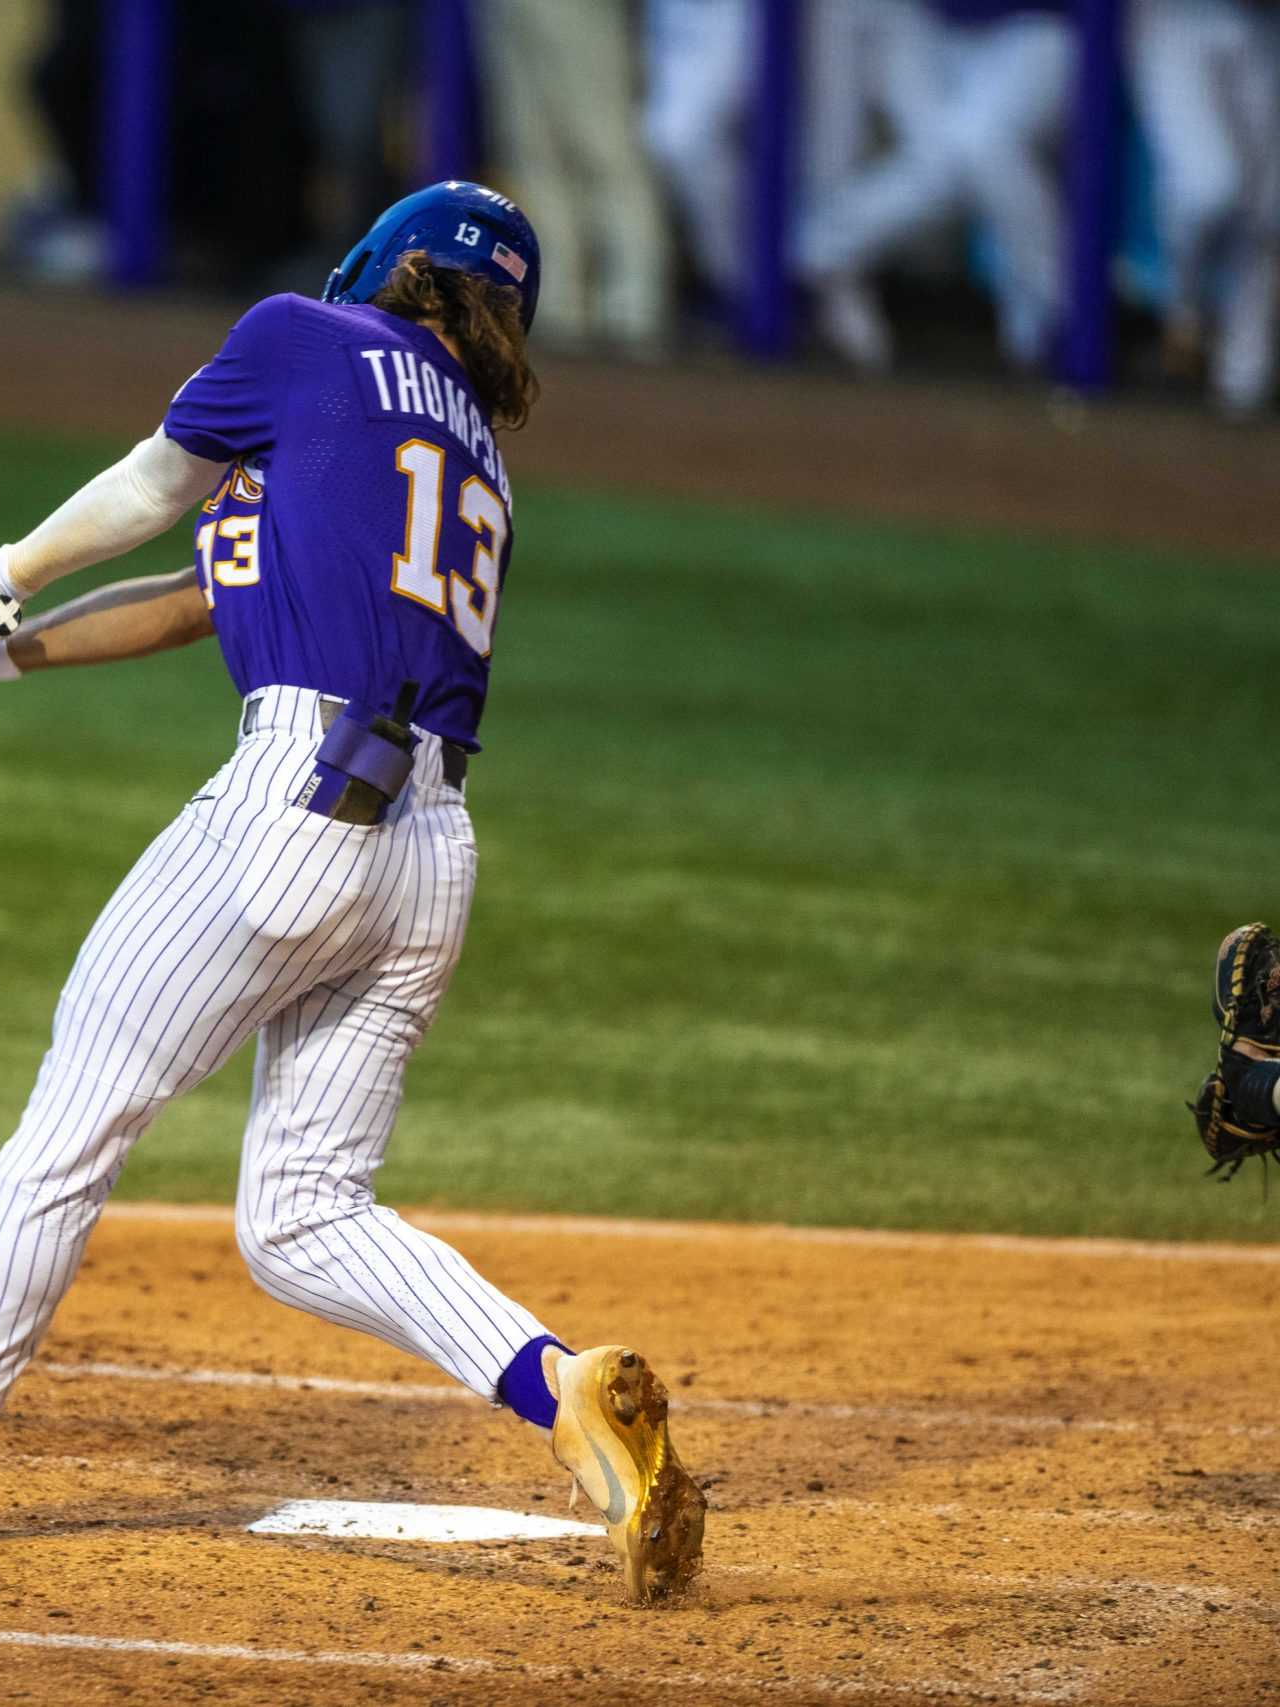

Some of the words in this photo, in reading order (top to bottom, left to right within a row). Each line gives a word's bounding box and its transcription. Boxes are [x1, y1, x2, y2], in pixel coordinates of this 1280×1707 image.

[454, 222, 481, 247] 13
[360, 349, 513, 520] THOMPSO
[196, 513, 261, 610] 13
[391, 437, 508, 658] 13
